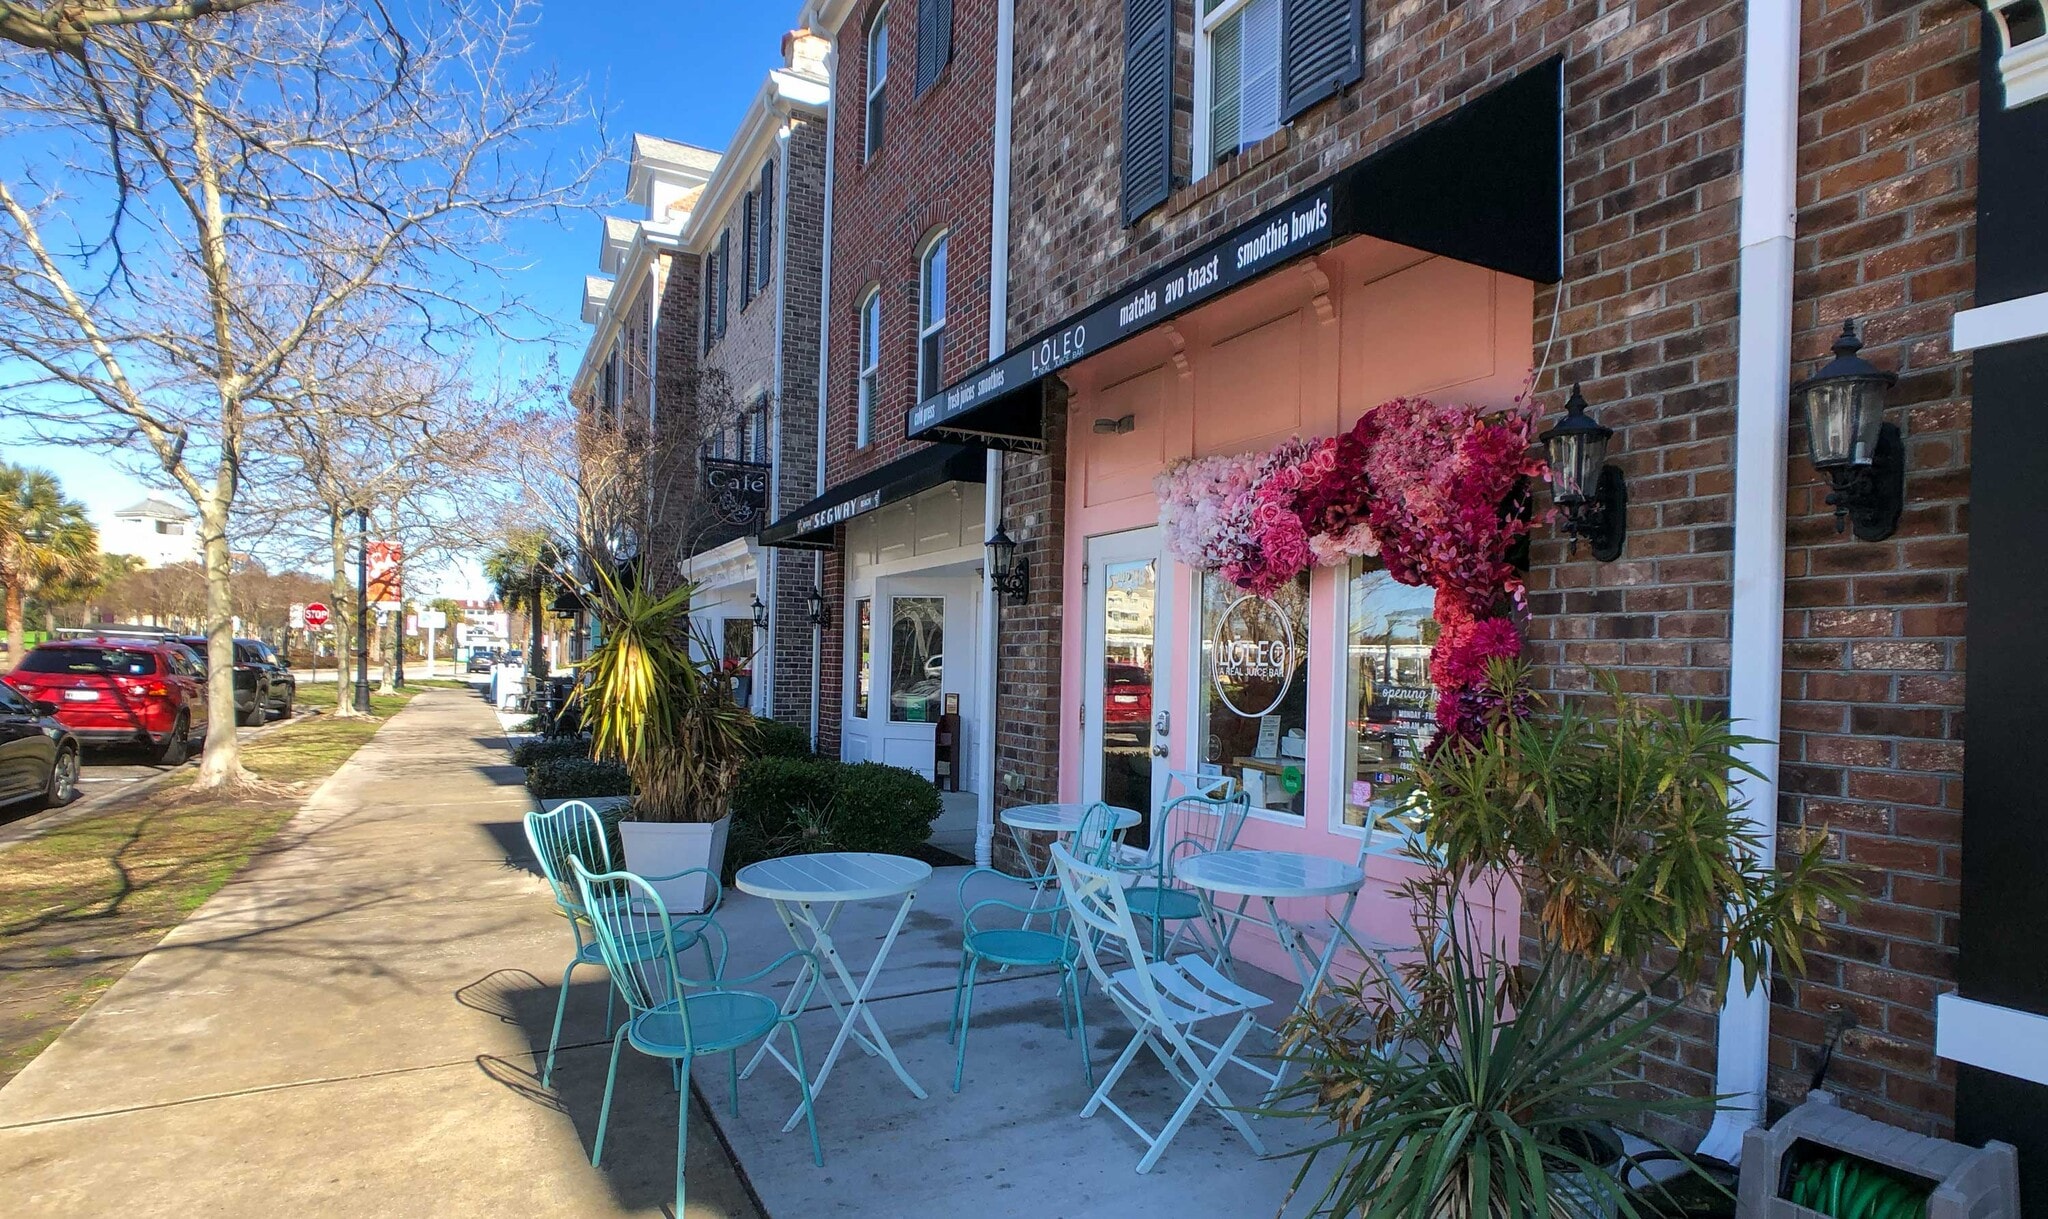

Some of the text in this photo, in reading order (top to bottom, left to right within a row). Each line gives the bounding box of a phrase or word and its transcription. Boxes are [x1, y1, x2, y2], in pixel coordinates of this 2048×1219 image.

[1237, 198, 1328, 268] smoothie bowls
[1119, 254, 1219, 327] matcha avo toast
[947, 367, 1005, 411] fresh juices smoothies
[709, 470, 764, 492] Café
[813, 498, 857, 529] SEGWAY
[306, 609, 327, 619] STOP
[1226, 667, 1244, 676] REAL
[1245, 667, 1268, 677] JUICE
[1268, 667, 1285, 678] BAR
[1382, 688, 1428, 708] opening
